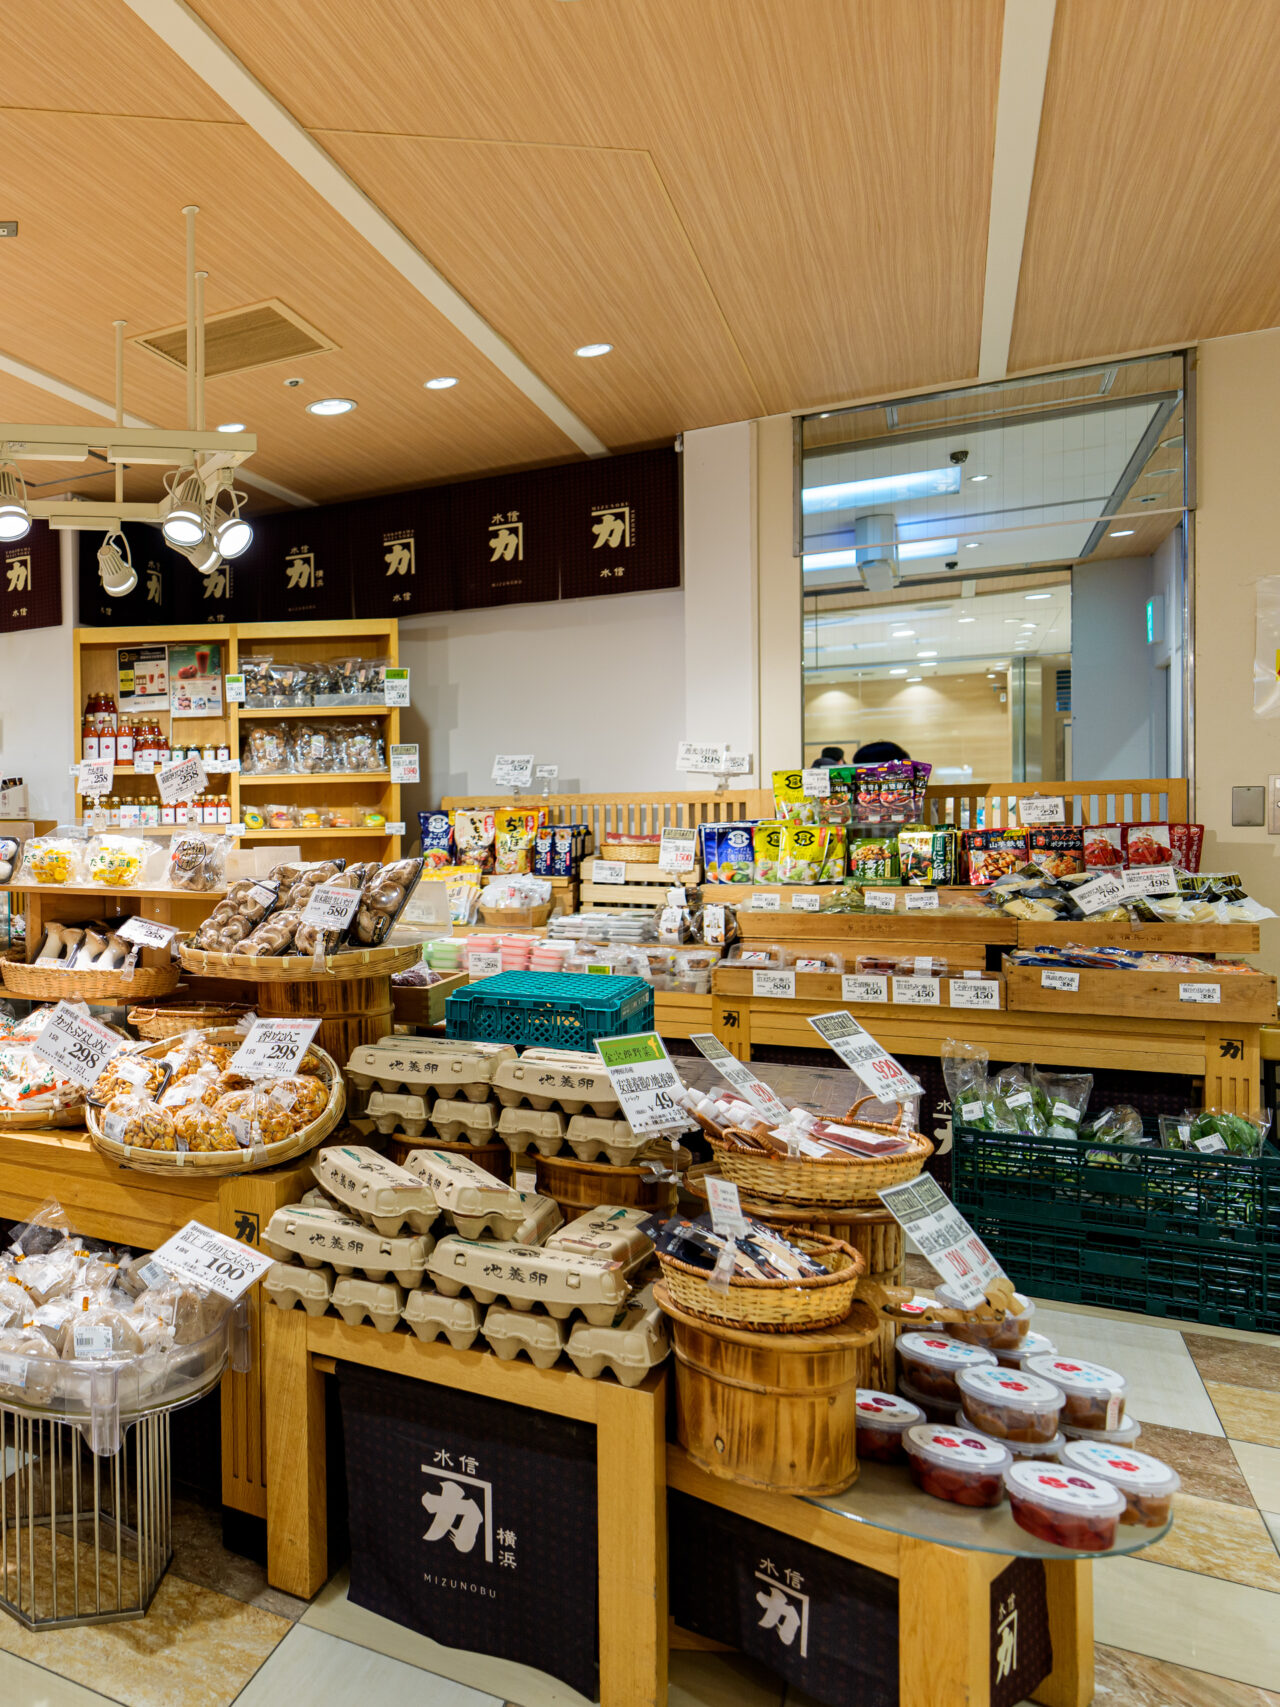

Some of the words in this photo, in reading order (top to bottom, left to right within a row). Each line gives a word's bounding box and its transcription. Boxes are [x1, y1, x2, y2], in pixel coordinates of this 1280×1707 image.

[491, 510, 520, 523] 水信
[591, 514, 625, 549] 力
[488, 528, 519, 562] 力
[384, 544, 411, 576] 力
[6, 561, 27, 592] 力
[286, 559, 311, 589] 力
[599, 566, 625, 578] 水信
[392, 592, 412, 602] 水信
[12, 607, 28, 617] 水信
[700, 755, 721, 764] 398
[93, 773, 108, 784] 258
[180, 770, 199, 785] 258
[1099, 886, 1120, 898] 780
[1148, 879, 1170, 887] 498
[326, 905, 348, 918] 580
[773, 983, 791, 991] 880
[862, 986, 883, 996] 450
[914, 989, 935, 999] 450
[972, 991, 994, 1000] 450
[67, 1041, 100, 1069] 298
[266, 1044, 300, 1060] 298
[388, 1059, 439, 1074] 地養卵
[871, 1059, 903, 1081] 920
[538, 1074, 595, 1089] 地養卵
[655, 1091, 674, 1109] 49
[234, 1215, 257, 1243] 力
[308, 1233, 365, 1255] 地養卵
[203, 1257, 245, 1280] 100
[483, 1263, 549, 1287] 地養卵
[433, 1448, 480, 1476] 水信
[421, 1480, 483, 1554] 力
[495, 1527, 518, 1570] 横浜
[759, 1557, 805, 1590] 水信
[423, 1572, 497, 1598] MIZUNOBU
[756, 1586, 801, 1646] 力
[996, 1626, 1014, 1686] 力
